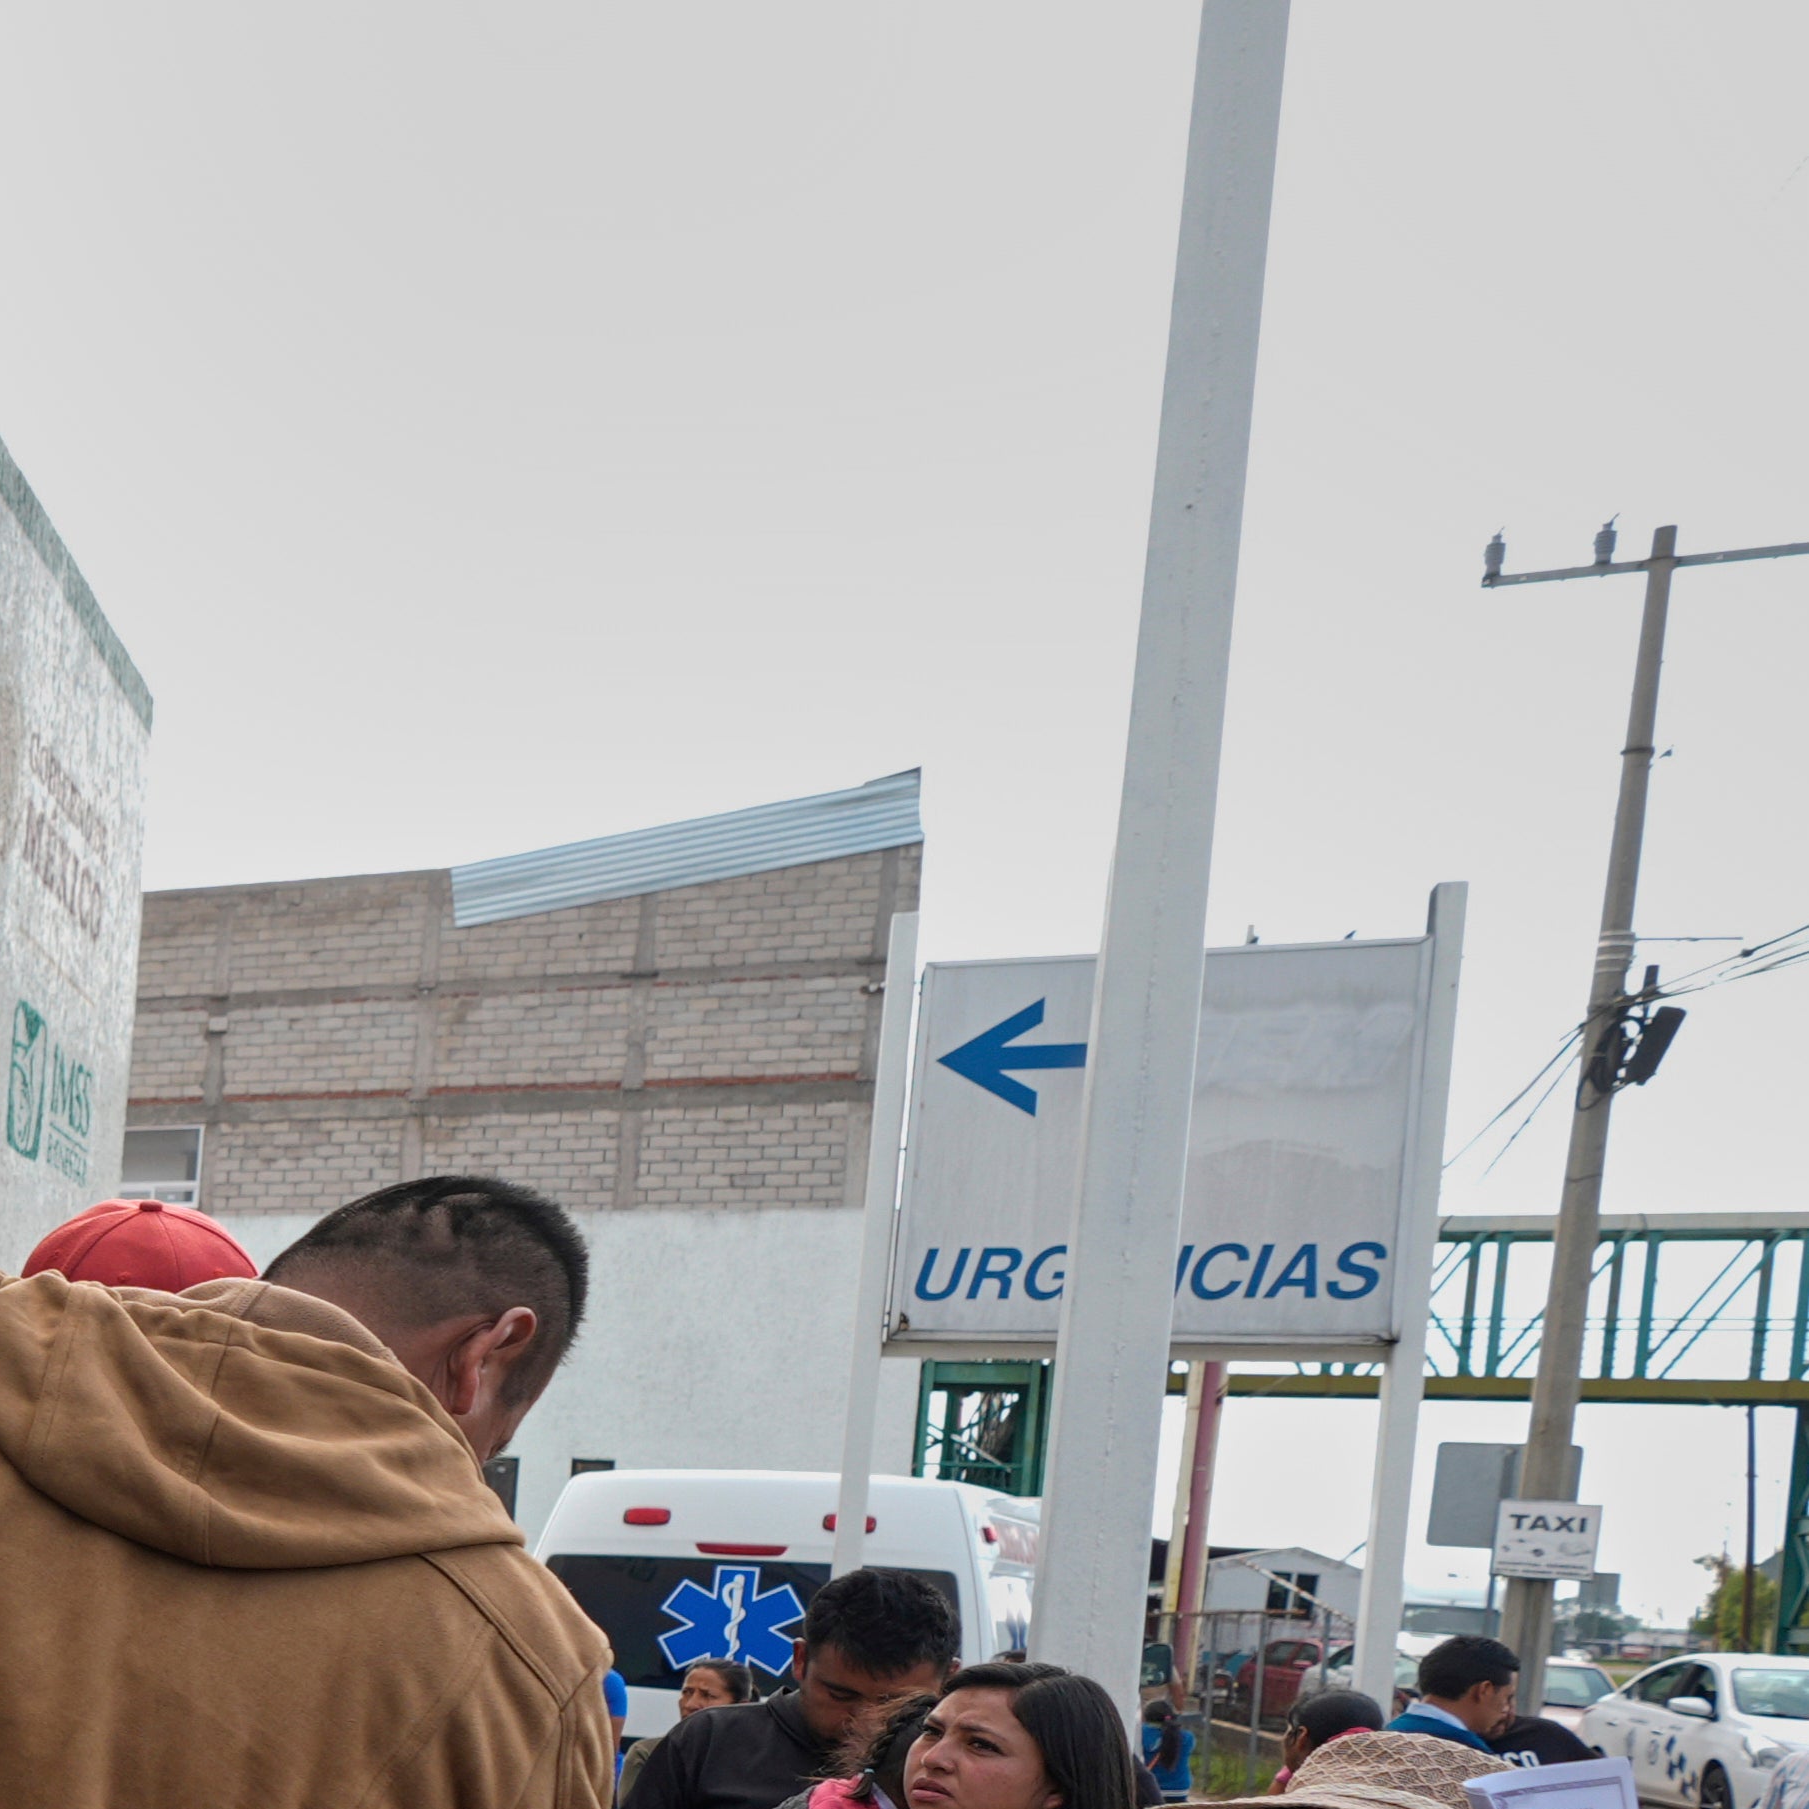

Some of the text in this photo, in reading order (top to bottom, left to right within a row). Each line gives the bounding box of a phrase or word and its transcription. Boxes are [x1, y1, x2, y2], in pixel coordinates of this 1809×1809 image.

[50, 1043, 93, 1137] IMSS
[914, 1242, 1387, 1301] URGCIAS
[1509, 1513, 1587, 1534] TAXI
